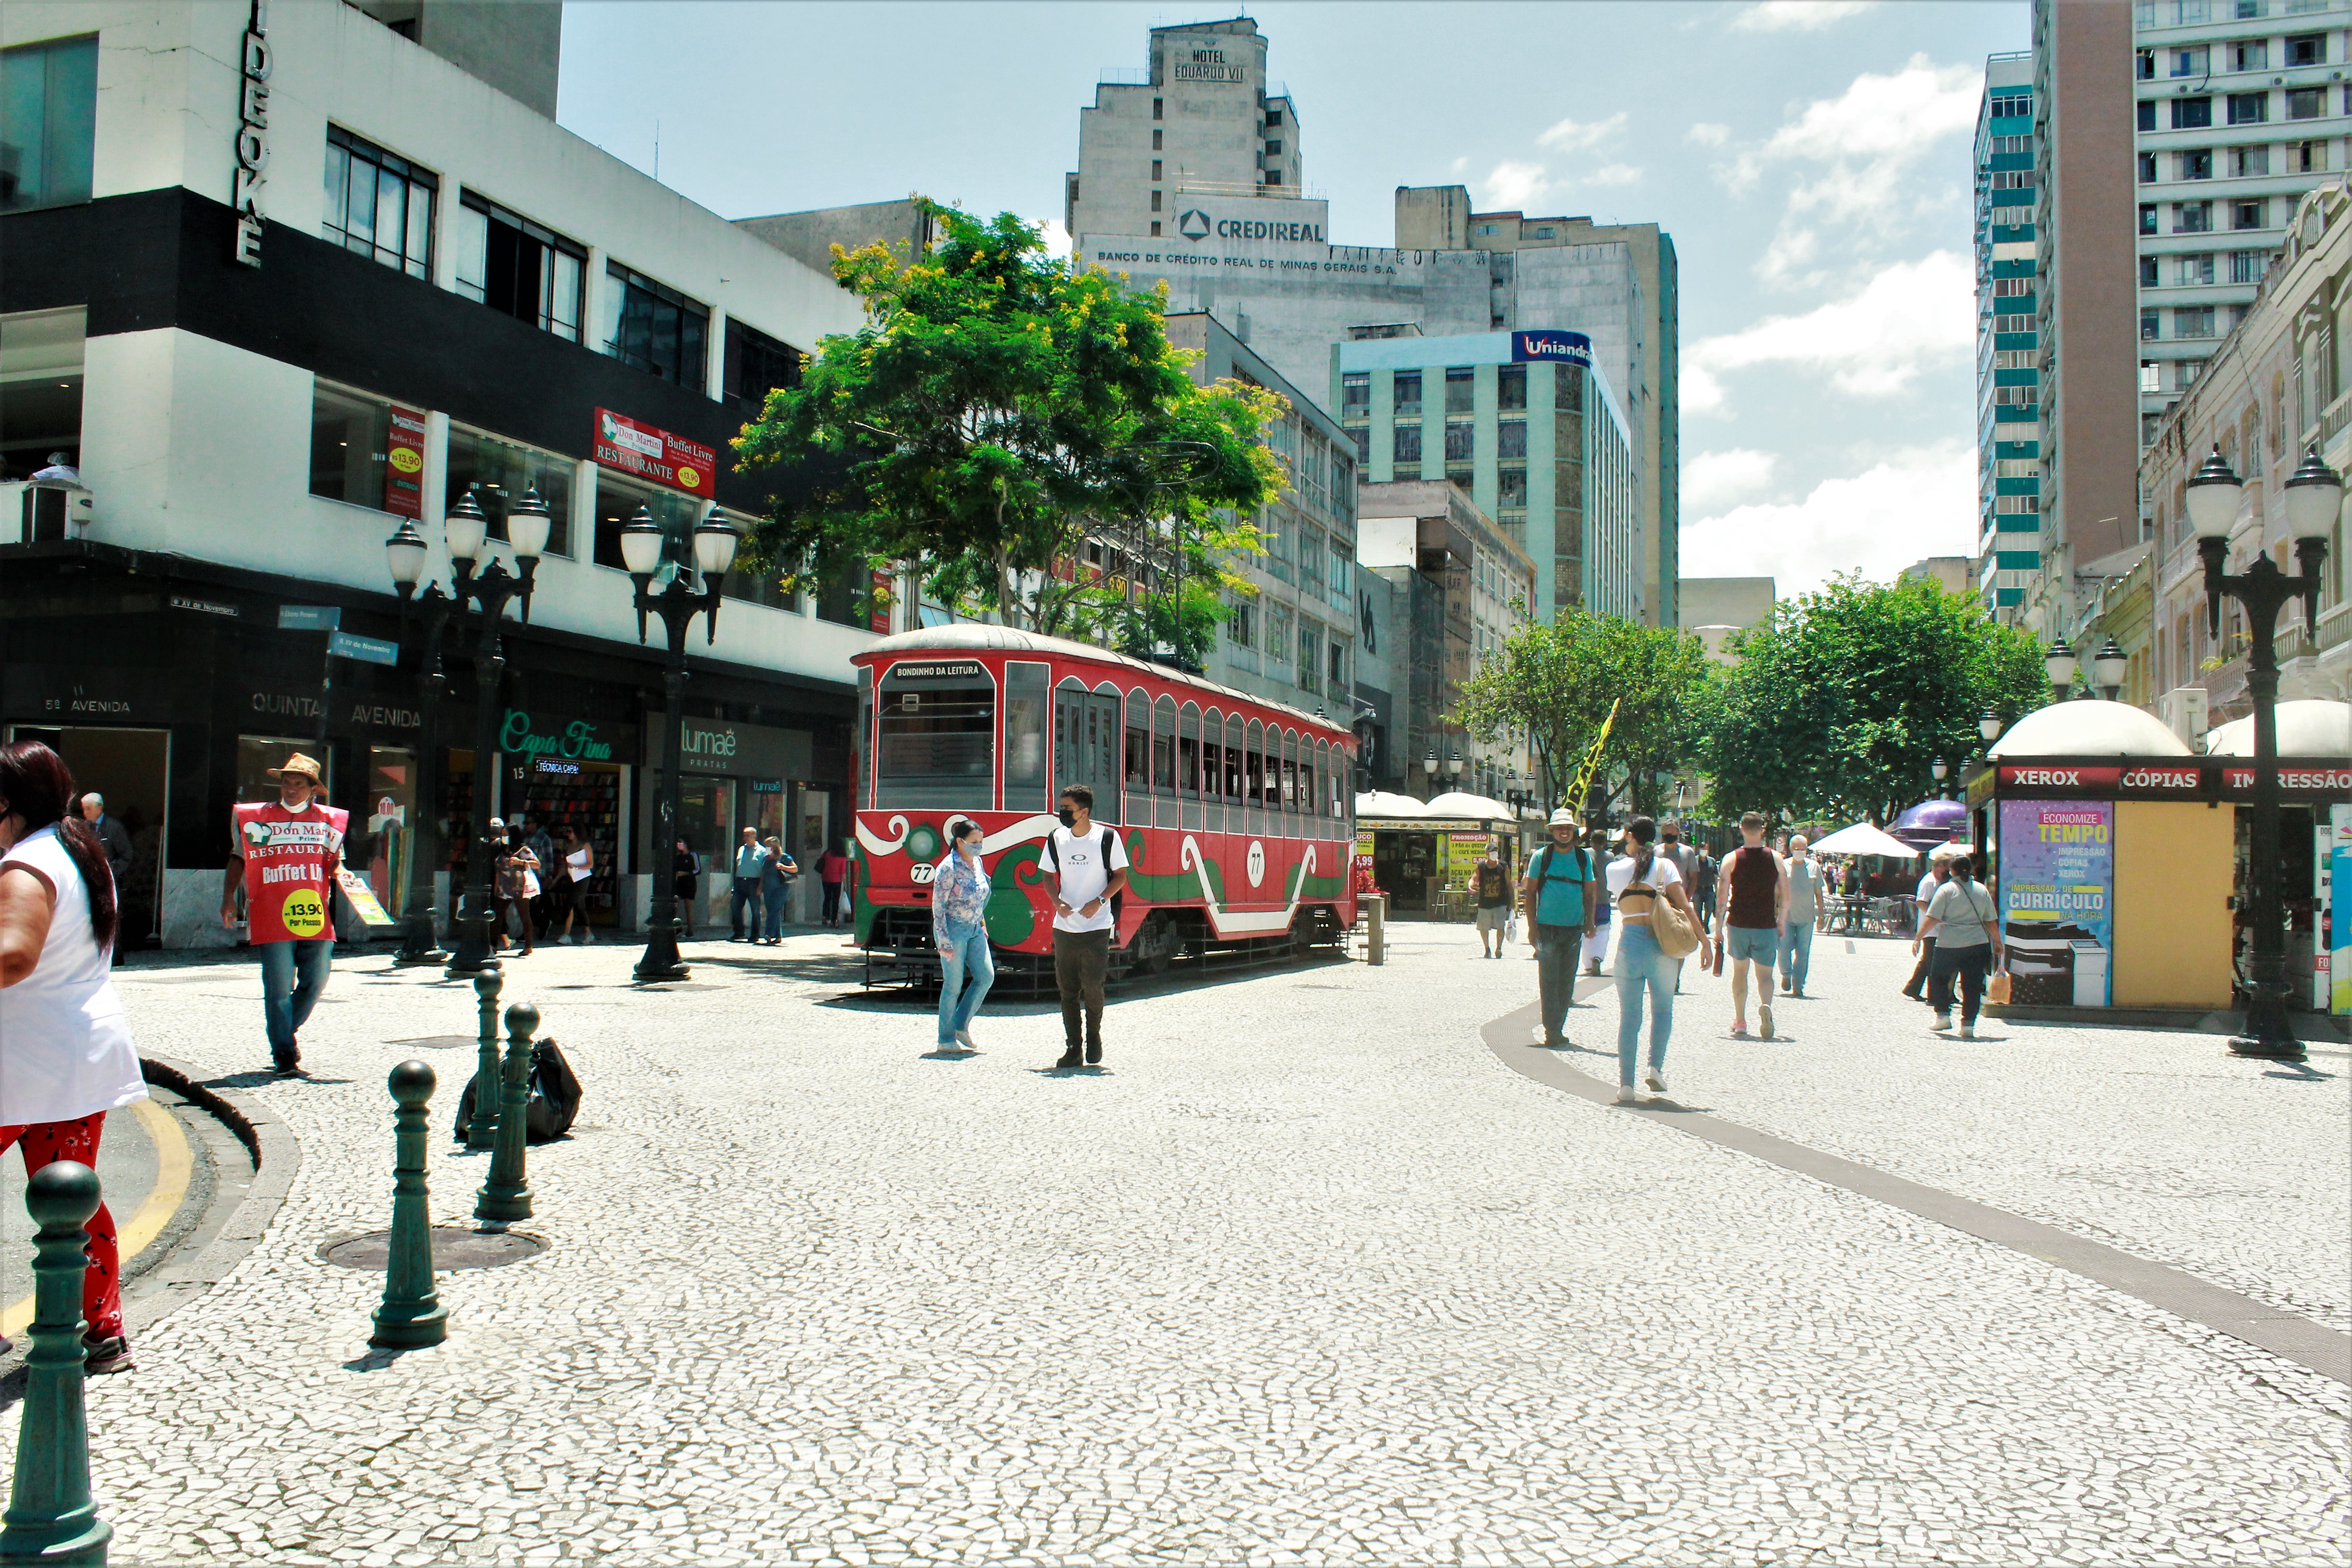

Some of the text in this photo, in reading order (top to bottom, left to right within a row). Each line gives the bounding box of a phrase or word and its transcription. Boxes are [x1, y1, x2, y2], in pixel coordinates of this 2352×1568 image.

[1193, 49, 1226, 63] HOTEL
[1176, 66, 1243, 80] EDUARDO VII
[1217, 219, 1324, 242] CREDIREAL
[1098, 252, 1397, 274] BANCO DE CRÉDITO REAL DE MINAS GERAIS S.A.
[390, 432, 424, 448] Buffet Livre
[618, 427, 662, 450] Don Martini
[667, 436, 692, 454] Buffet
[693, 445, 713, 462] Livre
[597, 445, 673, 480] RESTAURANTE
[204, 603, 234, 614] Novembro
[363, 642, 391, 654] Novembro
[897, 666, 979, 676] BONDINHO DA LEITURA
[71, 700, 130, 711] AVENIDA
[252, 693, 421, 728] QUINTA AVENIDA
[500, 708, 612, 764] Capa Fina
[539, 760, 562, 771] TÉCNICA
[690, 759, 727, 769] PRATAS
[513, 767, 524, 779] 15
[2014, 768, 2352, 789] XEROX CÓPIAS IMRESSÃO
[2043, 813, 2097, 823] ECONOMIZE
[273, 825, 299, 835] Don
[2037, 824, 2107, 843] TEMPO
[250, 844, 332, 861] RESTAURA
[1252, 853, 1260, 874] 77
[263, 864, 306, 884] Buffet
[913, 867, 931, 881] 77
[2058, 870, 2085, 878] XEROX
[2008, 890, 2104, 910] CURRÍCULO
[290, 904, 323, 916] 13,90
[2059, 911, 2103, 920] NA HORA
